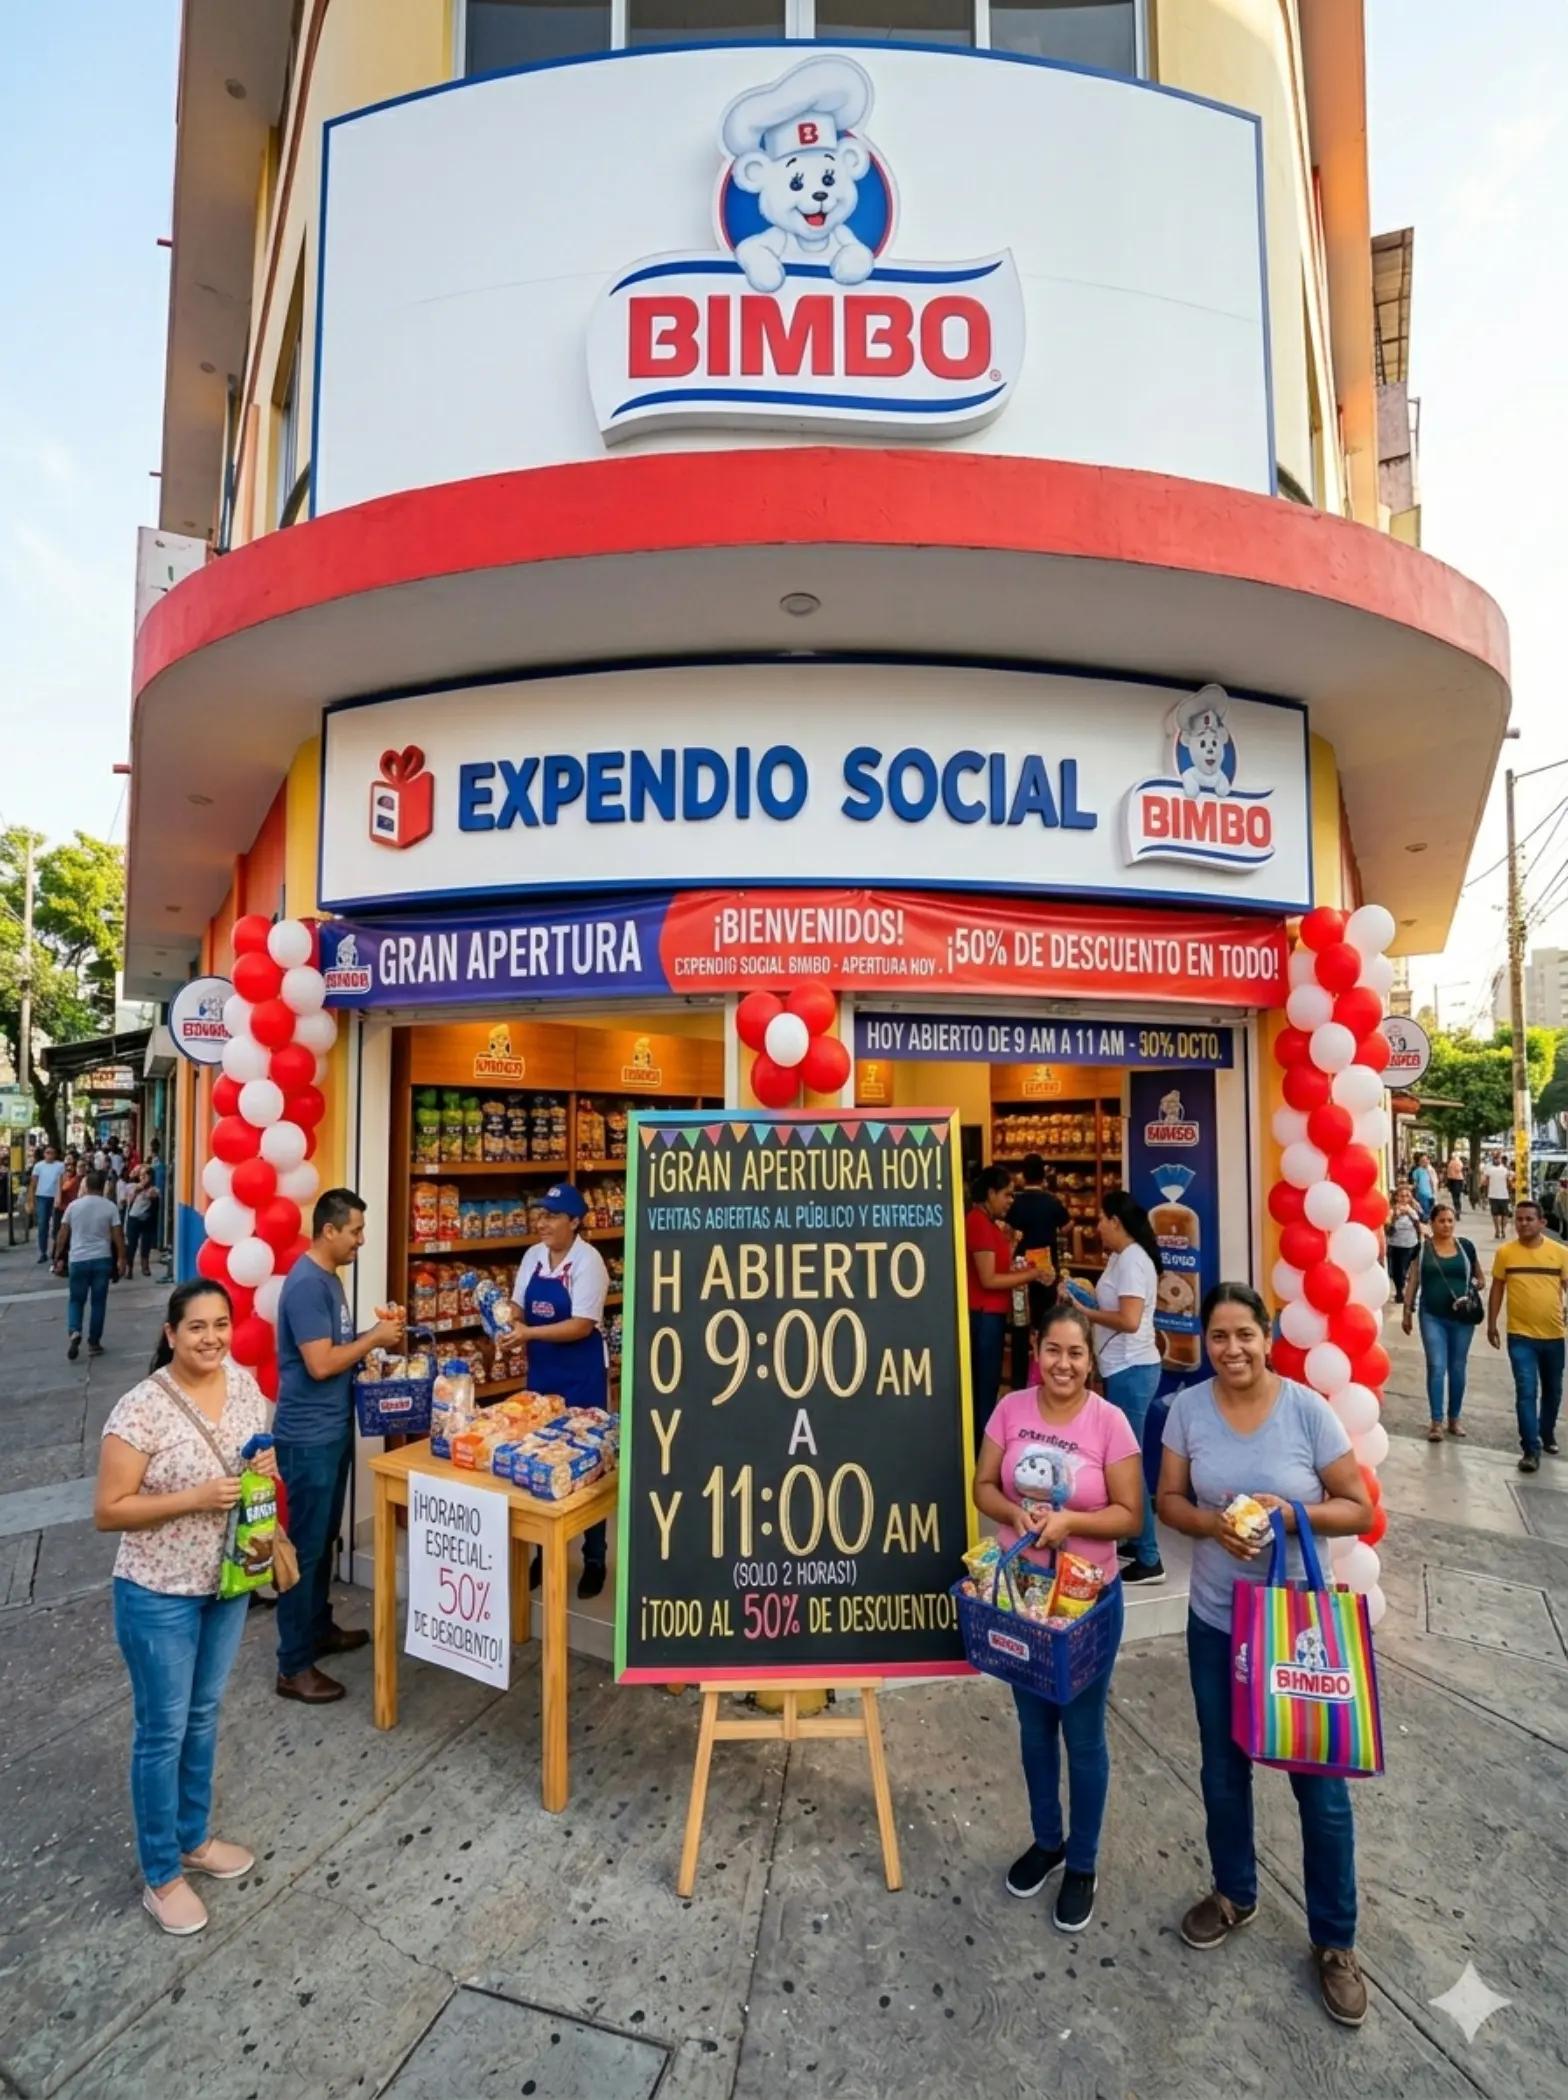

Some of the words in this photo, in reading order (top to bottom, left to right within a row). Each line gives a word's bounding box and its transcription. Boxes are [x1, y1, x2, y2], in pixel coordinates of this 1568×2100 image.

[798, 122, 819, 145] B
[628, 294, 992, 381] BIMBO
[458, 744, 809, 832] EXPENDIO
[841, 745, 1098, 831] SOCIAL
[1141, 794, 1272, 848] BIMBO
[379, 932, 458, 985] GRAN
[466, 919, 643, 980] APERTURA
[713, 907, 905, 953] ¡BIENVENIDOS!
[946, 926, 1007, 974] ¡50%
[1014, 930, 1045, 968] DE
[1050, 932, 1181, 976] DESCUENTO
[1186, 941, 1214, 978] EN
[1218, 943, 1280, 981] TODO!
[867, 1021, 905, 1050] HOY
[908, 1023, 983, 1052] ABIERTO
[987, 1025, 1011, 1053] DE
[1014, 1026, 1025, 1054] 9
[1029, 1026, 1056, 1055] AM
[1060, 1027, 1072, 1055] A
[1075, 1028, 1095, 1056] 11
[1098, 1029, 1125, 1057] AM
[649, 1149, 732, 1199] ¡GRAN
[741, 1148, 874, 1193] APERTURA
[882, 1144, 945, 1191] HOY!
[774, 1205, 792, 1229] AL
[858, 1204, 869, 1228] Y
[700, 1241, 926, 1301] ABIERTO
[704, 1307, 868, 1407] 9:00
[875, 1347, 933, 1397] AM
[788, 1408, 818, 1456] A
[414, 1489, 482, 1537] ¡HORARIO
[701, 1462, 875, 1559] 11:00
[883, 1503, 941, 1554] AM
[438, 1567, 492, 1624] 50%
[732, 1561, 778, 1590] (SOLO
[782, 1561, 793, 1586] 2
[641, 1596, 702, 1641] ¡TODO
[709, 1600, 735, 1637] AL
[743, 1592, 800, 1640] 50%
[809, 1596, 833, 1634] DE
[839, 1592, 960, 1633] DESCUENTO!
